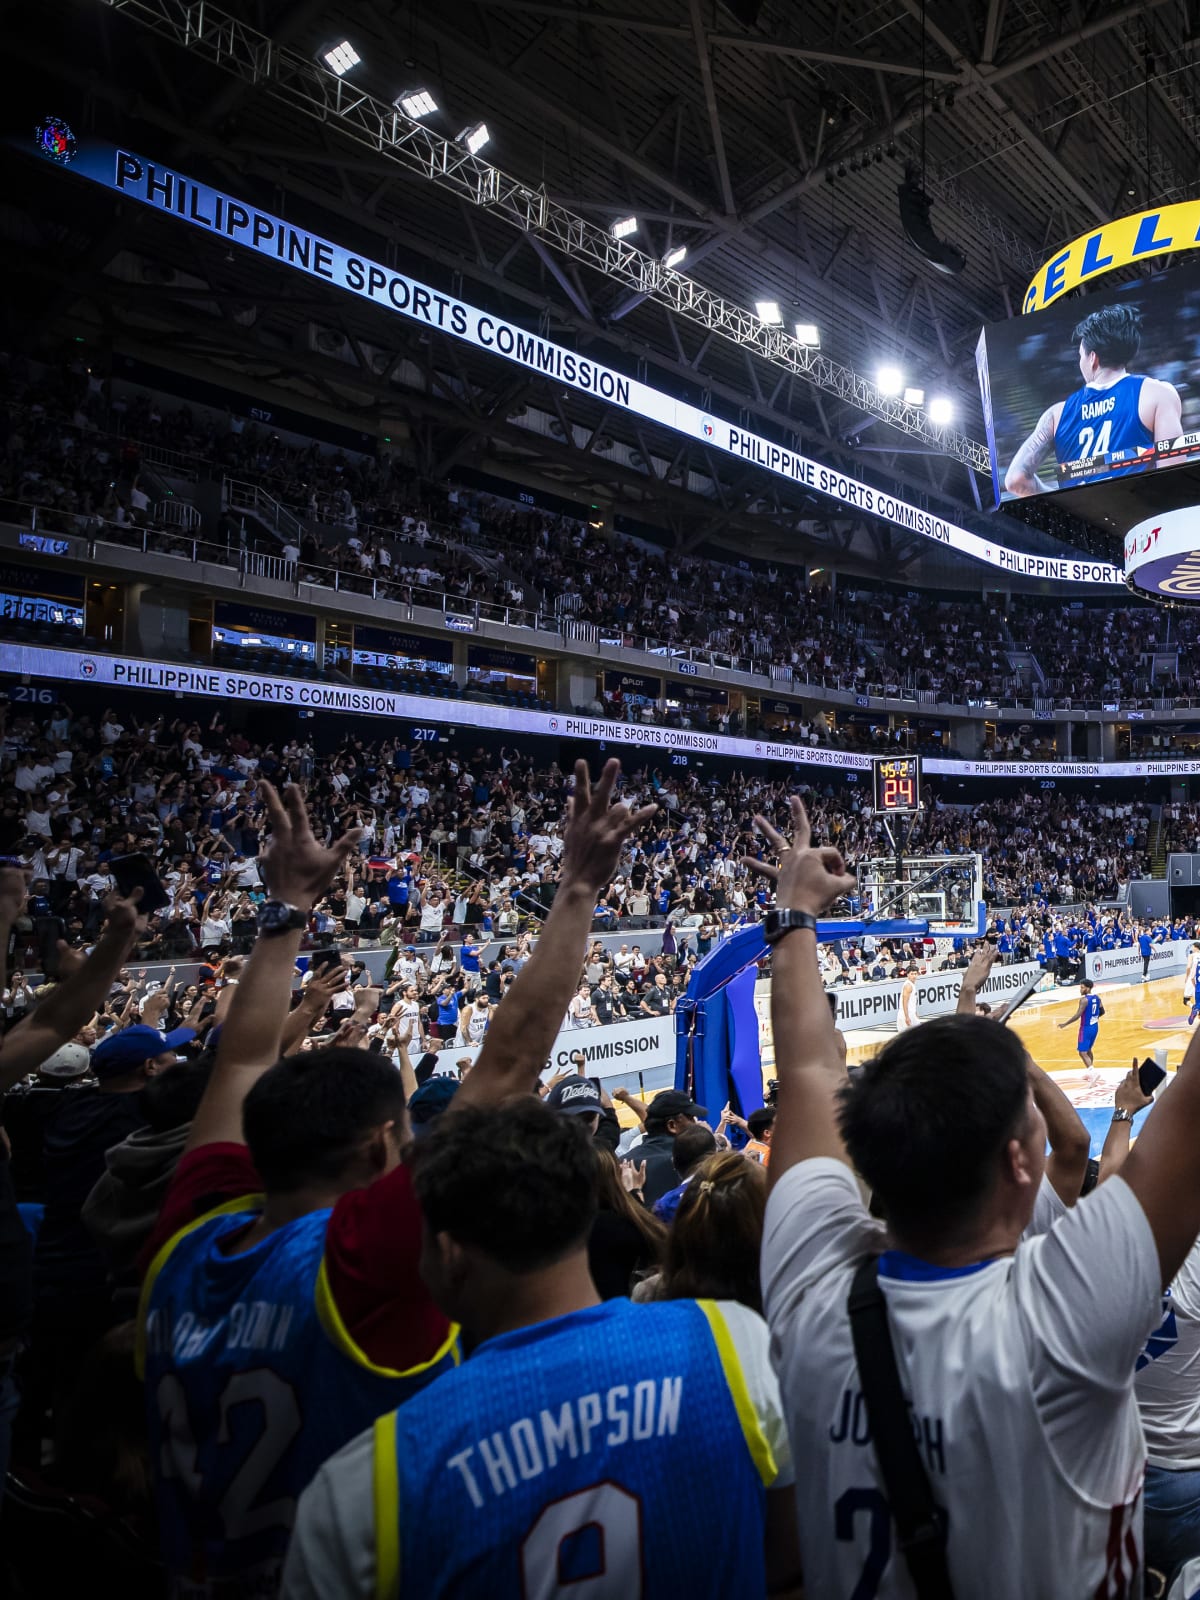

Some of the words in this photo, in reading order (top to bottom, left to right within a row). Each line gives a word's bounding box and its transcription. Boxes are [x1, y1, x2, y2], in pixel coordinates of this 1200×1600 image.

[115, 150, 334, 279] PHILIPPINE
[345, 257, 467, 335] SPORTS
[477, 317, 630, 406] COMMISSION
[1081, 396, 1116, 421] RAMOS
[1078, 420, 1112, 460] 24
[1111, 450, 1125, 461] PHI
[1157, 440, 1170, 451] 66
[1184, 434, 1199, 445] NZL
[728, 428, 815, 486] PHILIPPINE
[819, 469, 874, 511] SPORTS
[877, 496, 950, 544] COMMISSION
[1000, 550, 1068, 578] PHILIPPINE
[1072, 564, 1126, 583] SPORTS
[680, 663, 696, 675] 418
[14, 686, 53, 704] 216
[114, 664, 220, 692] PHILIPPINE
[226, 679, 294, 701] SPORTS
[299, 688, 396, 713] COMMISSION
[413, 728, 437, 741] 217
[566, 720, 621, 739] PHILIPPINE
[624, 727, 661, 744] SPORTS
[664, 732, 718, 750] COMMISSION
[672, 755, 689, 766] 218
[766, 746, 805, 761] PHILIPPINE
[806, 751, 833, 765] SPORTS
[1147, 763, 1188, 774] PHILIPPINE
[975, 764, 1017, 775] PHILIPPINE
[1018, 764, 1050, 775] SPORTS
[1052, 765, 1099, 775] COMMISSION
[885, 780, 912, 806] 24
[1041, 781, 1056, 789] 220
[1105, 958, 1130, 969] PHILIPPINE
[1130, 956, 1144, 966] SPORT
[1150, 950, 1174, 961] OMMISSION
[836, 992, 901, 1020] HILIPPIN
[917, 981, 961, 1005] PORTS
[975, 970, 1036, 995] MMISSIO
[557, 1035, 660, 1067] COMMISSION
[447, 1375, 683, 1508] THOMPSON
